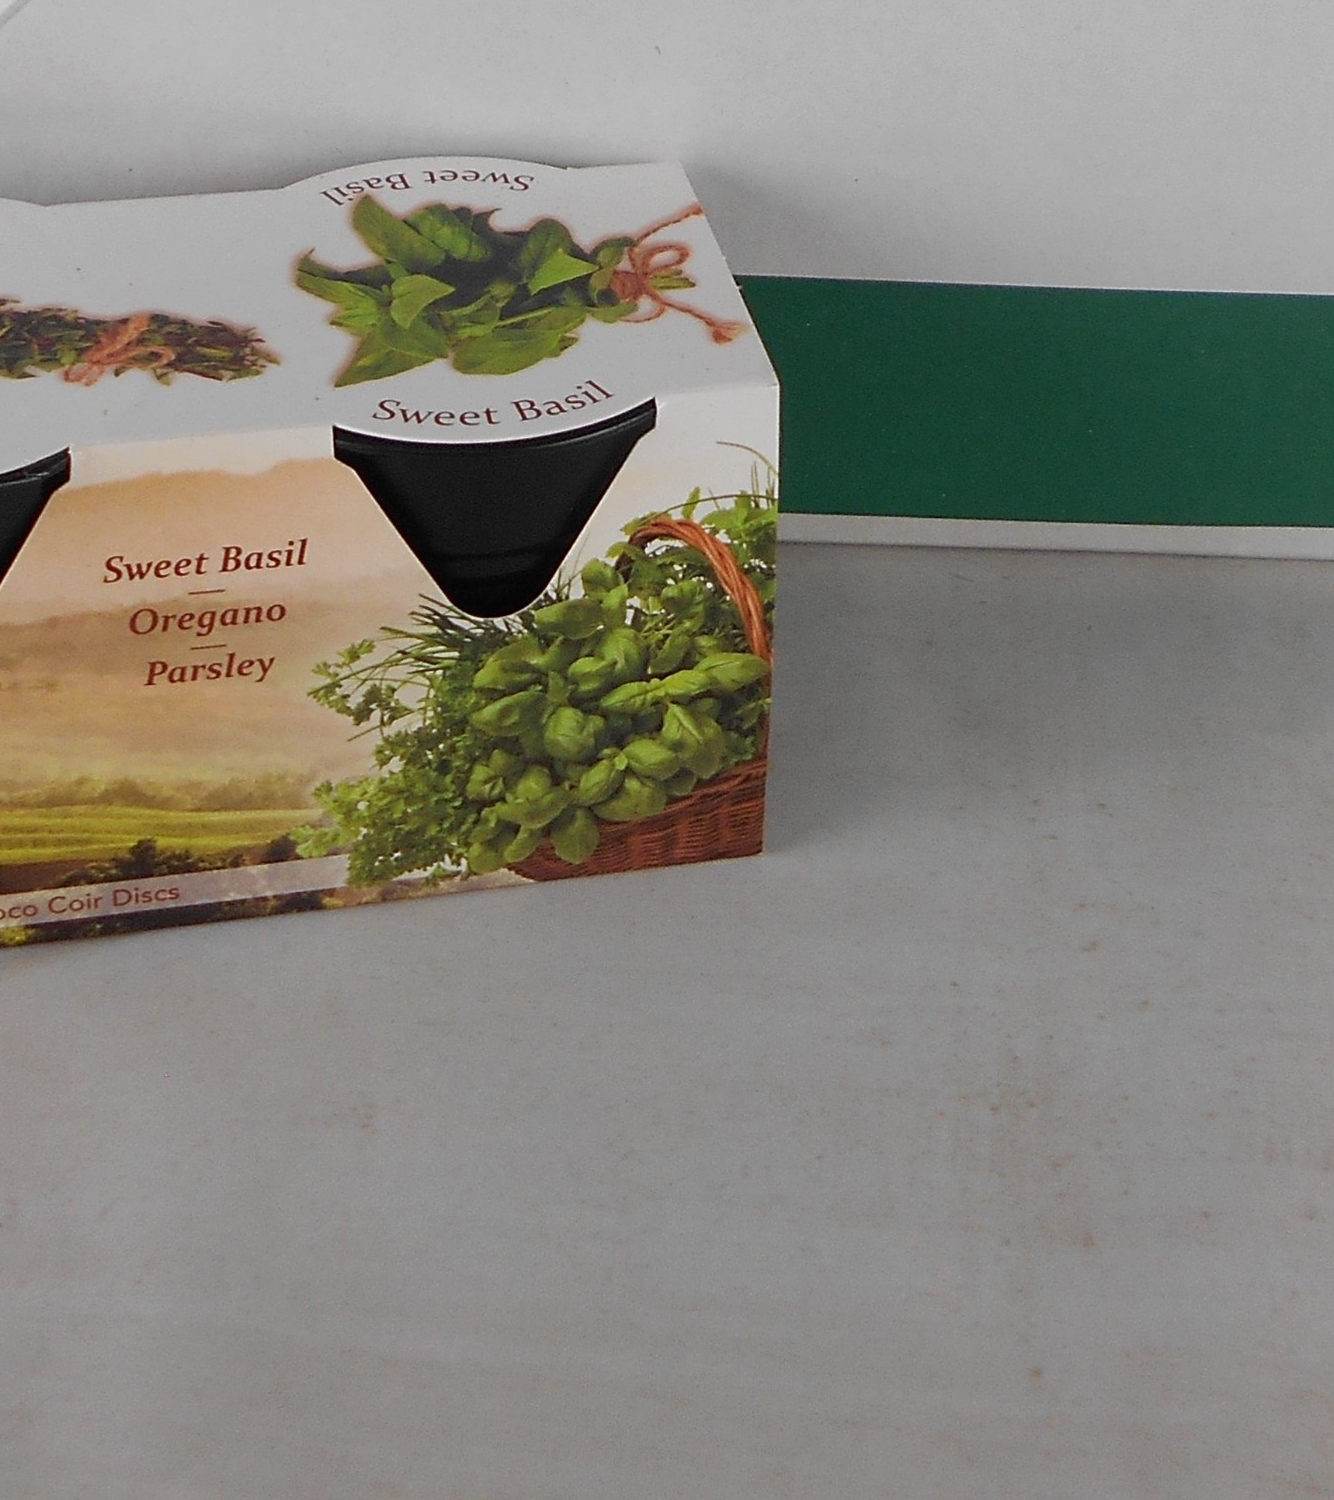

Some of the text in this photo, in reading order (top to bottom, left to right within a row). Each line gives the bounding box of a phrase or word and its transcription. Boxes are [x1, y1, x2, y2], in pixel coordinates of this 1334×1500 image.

[319, 167, 536, 210] Sweet Basil
[371, 380, 615, 430] Sweet Basil
[101, 537, 310, 586] Sweet Basil
[128, 598, 288, 639] Oregano
[144, 650, 277, 688] Parsley
[46, 890, 103, 918] Coir
[111, 881, 182, 910] Discs
